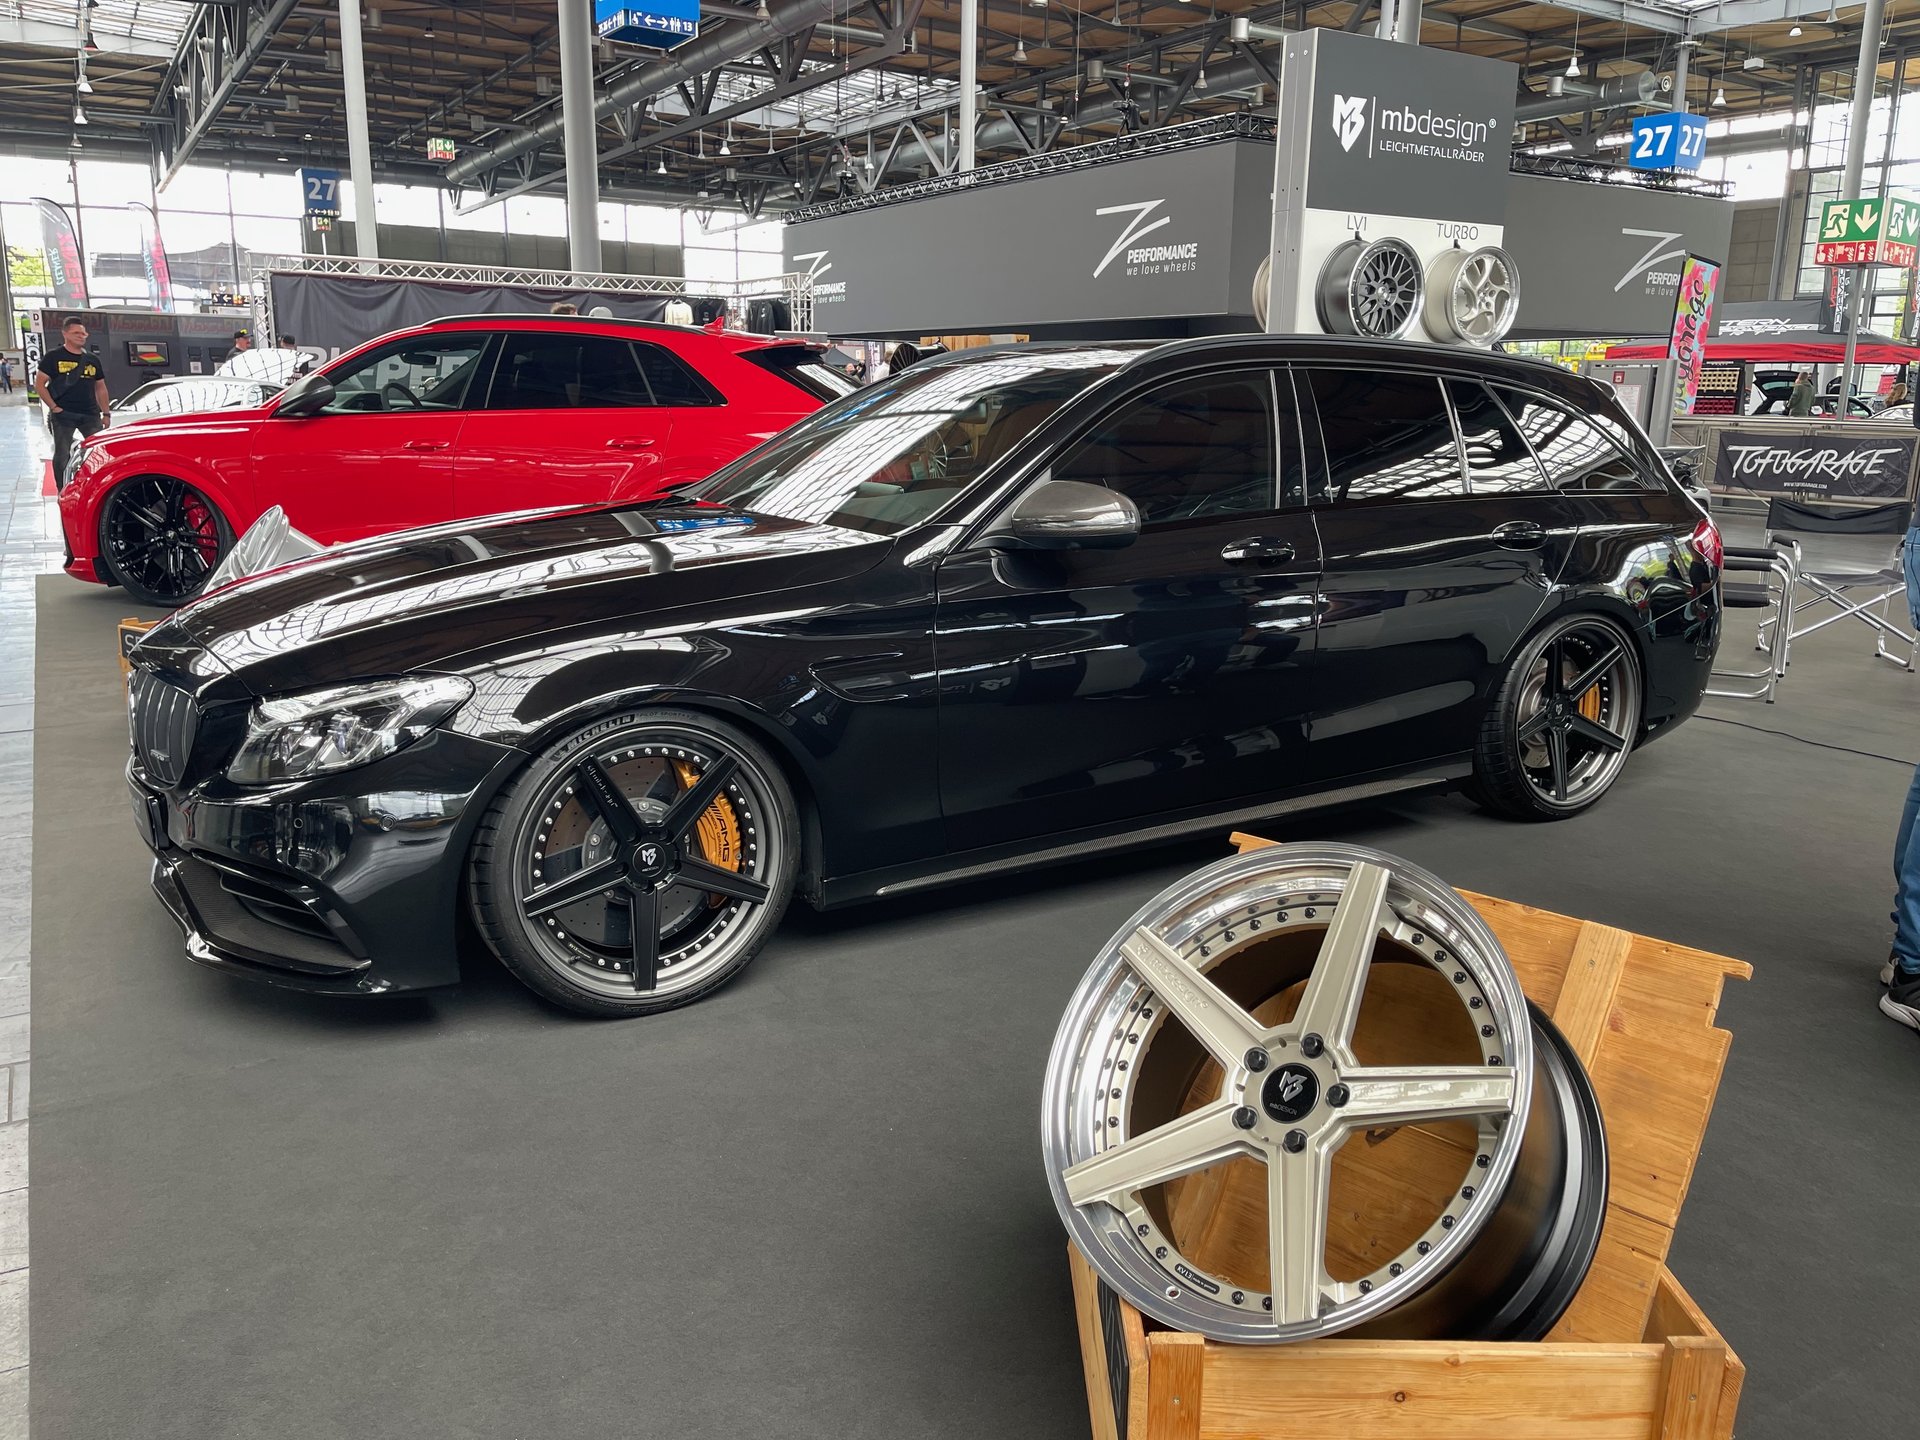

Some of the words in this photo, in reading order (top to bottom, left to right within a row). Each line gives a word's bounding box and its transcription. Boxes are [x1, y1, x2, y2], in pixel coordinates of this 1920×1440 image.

[682, 22, 692, 32] 13
[1380, 140, 1485, 162] LEICHTMETALLRÄDER
[1636, 124, 1672, 158] 27
[1680, 124, 1704, 157] 27
[308, 178, 336, 200] 27
[1437, 223, 1478, 240] TURBO
[1126, 243, 1198, 264] PERFORMANCE
[1126, 266, 1138, 276] we
[1141, 264, 1160, 274] love
[1164, 260, 1196, 272] wheels
[813, 282, 846, 296] ERFORMANCE
[829, 294, 846, 302] wheels
[1645, 287, 1655, 295] we
[1658, 286, 1674, 296] love
[1728, 445, 1902, 480] TOFUGARAGE
[568, 714, 633, 750] MICHELIN
